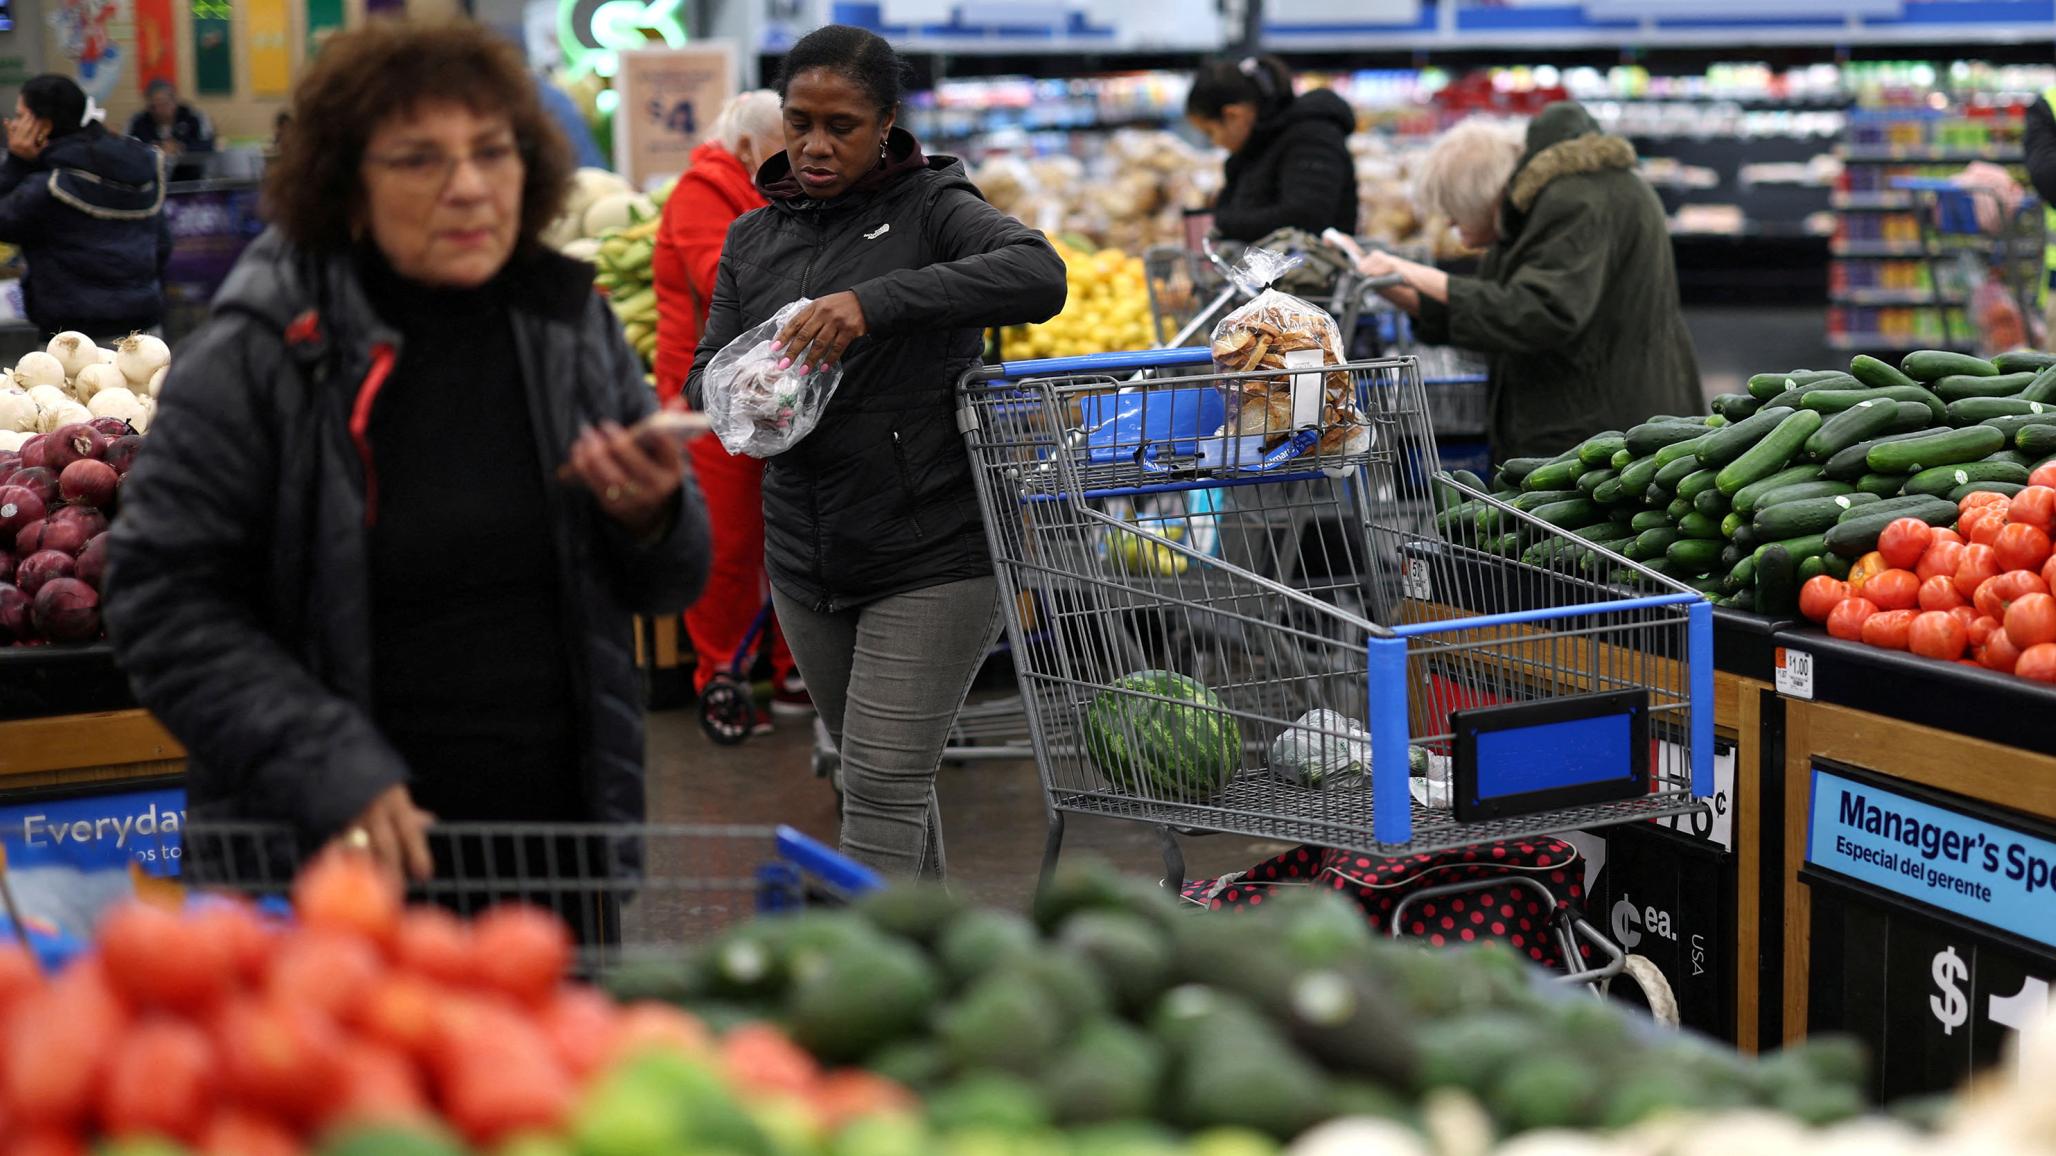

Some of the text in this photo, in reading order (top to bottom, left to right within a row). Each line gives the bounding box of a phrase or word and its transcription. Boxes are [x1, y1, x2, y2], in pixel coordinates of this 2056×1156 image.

[1836, 835, 1992, 902] Especial del gerente
[1839, 790, 2056, 893] Manager's Sp
[1691, 934, 1705, 976] USA
